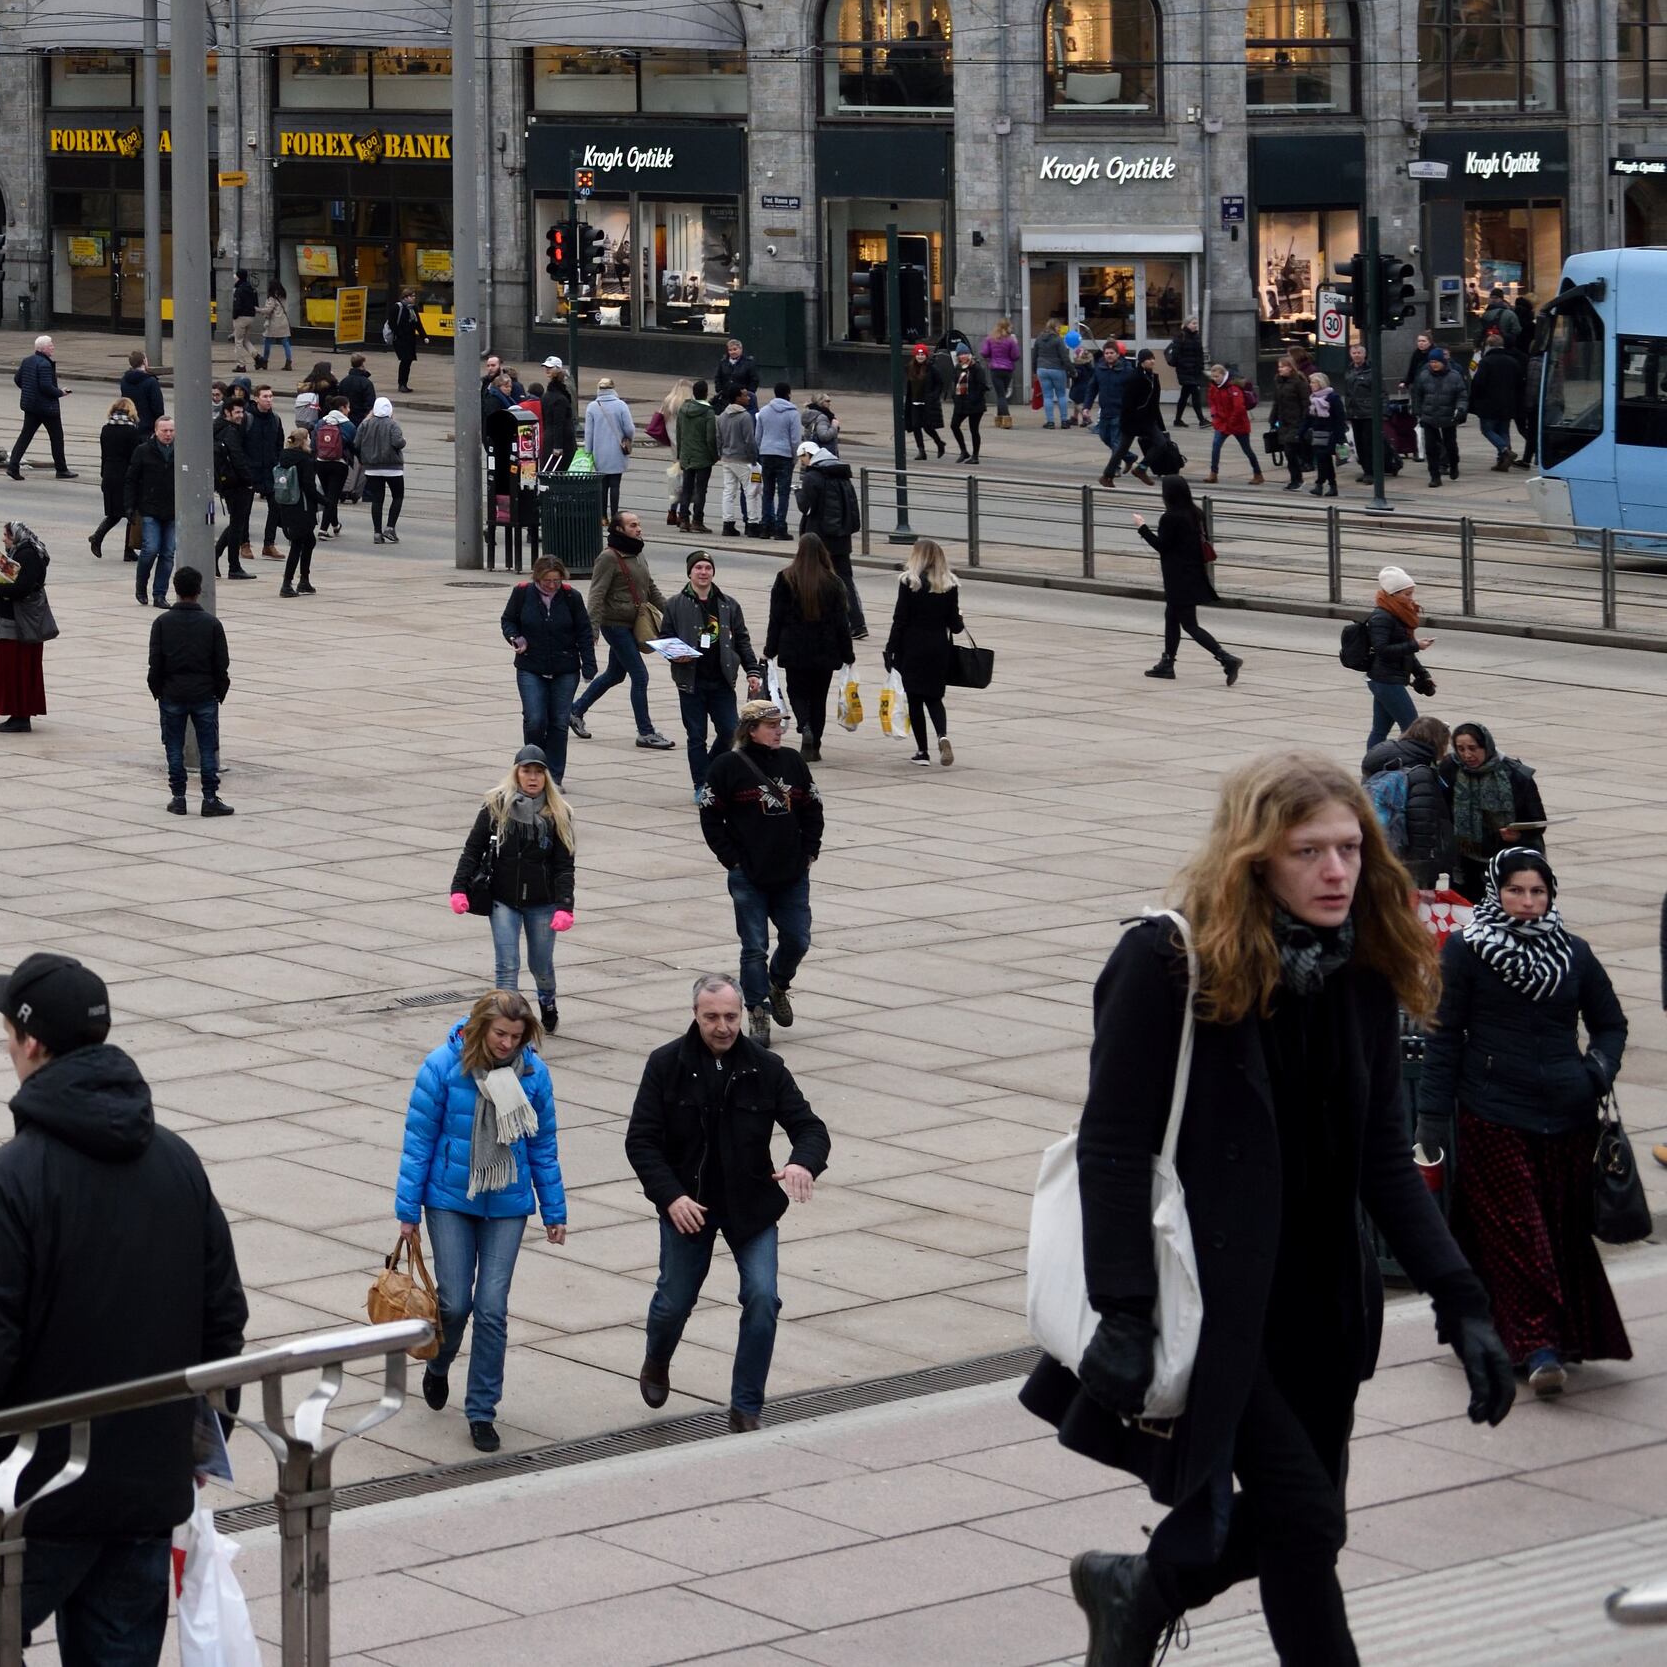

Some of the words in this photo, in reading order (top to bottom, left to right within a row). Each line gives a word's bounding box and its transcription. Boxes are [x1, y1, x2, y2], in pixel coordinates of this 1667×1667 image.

[51, 130, 117, 152] FOREX
[280, 132, 354, 157] FOREX
[384, 134, 452, 159] BANK
[583, 145, 623, 173] Krogh
[626, 146, 674, 173] Optikk
[1039, 156, 1100, 185] Krogh
[1106, 156, 1177, 185] Optikk
[1465, 151, 1499, 179] Krogh
[1501, 151, 1541, 179] Optikk
[1614, 160, 1638, 174] Krogh
[1639, 161, 1666, 174] Optikk
[581, 188, 591, 196] 40
[1326, 316, 1340, 332] 30
[17, 1002, 33, 1024] R
